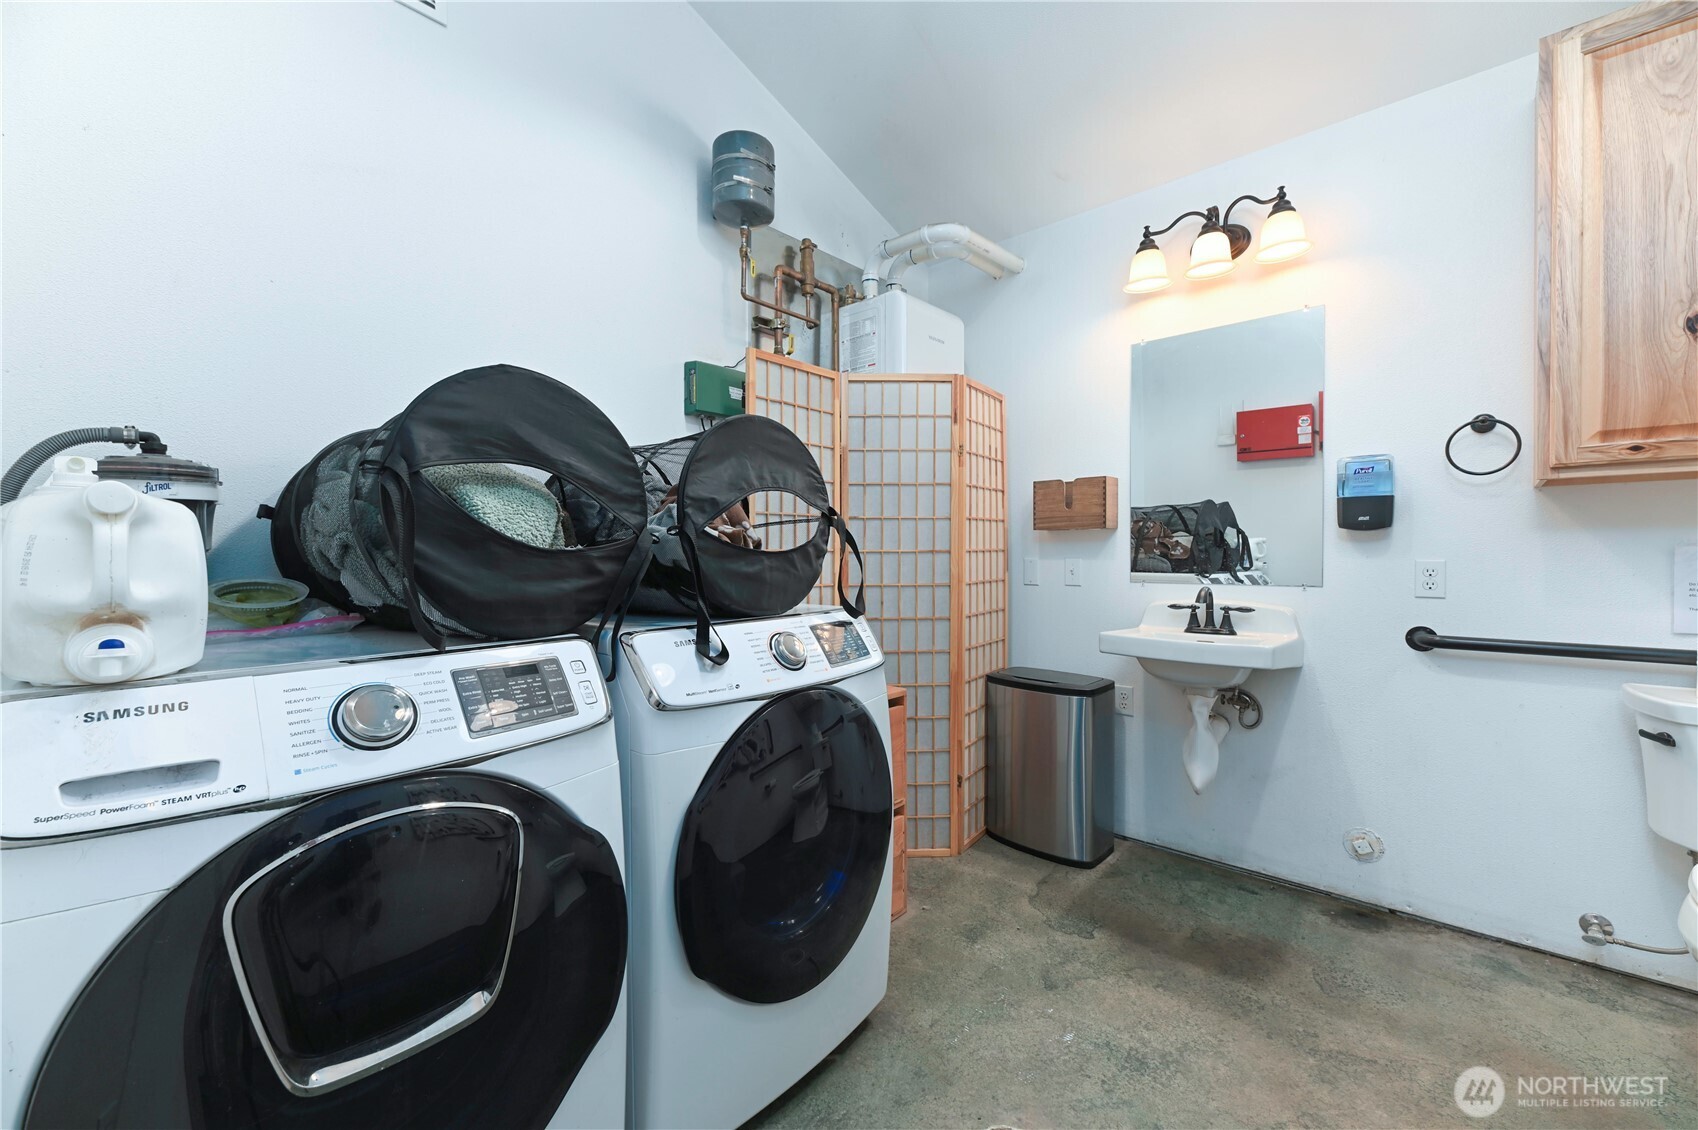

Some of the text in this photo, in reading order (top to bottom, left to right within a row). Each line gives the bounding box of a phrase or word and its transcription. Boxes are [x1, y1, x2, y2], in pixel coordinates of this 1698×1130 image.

[83, 701, 189, 723] SAMSUNG
[286, 707, 313, 715] BEDDING
[290, 728, 317, 737] SANITIZE
[291, 739, 322, 748] ALLERGEN
[293, 751, 310, 759] RINSE
[33, 809, 97, 824] SuperSpeed
[161, 795, 193, 806] STEAM
